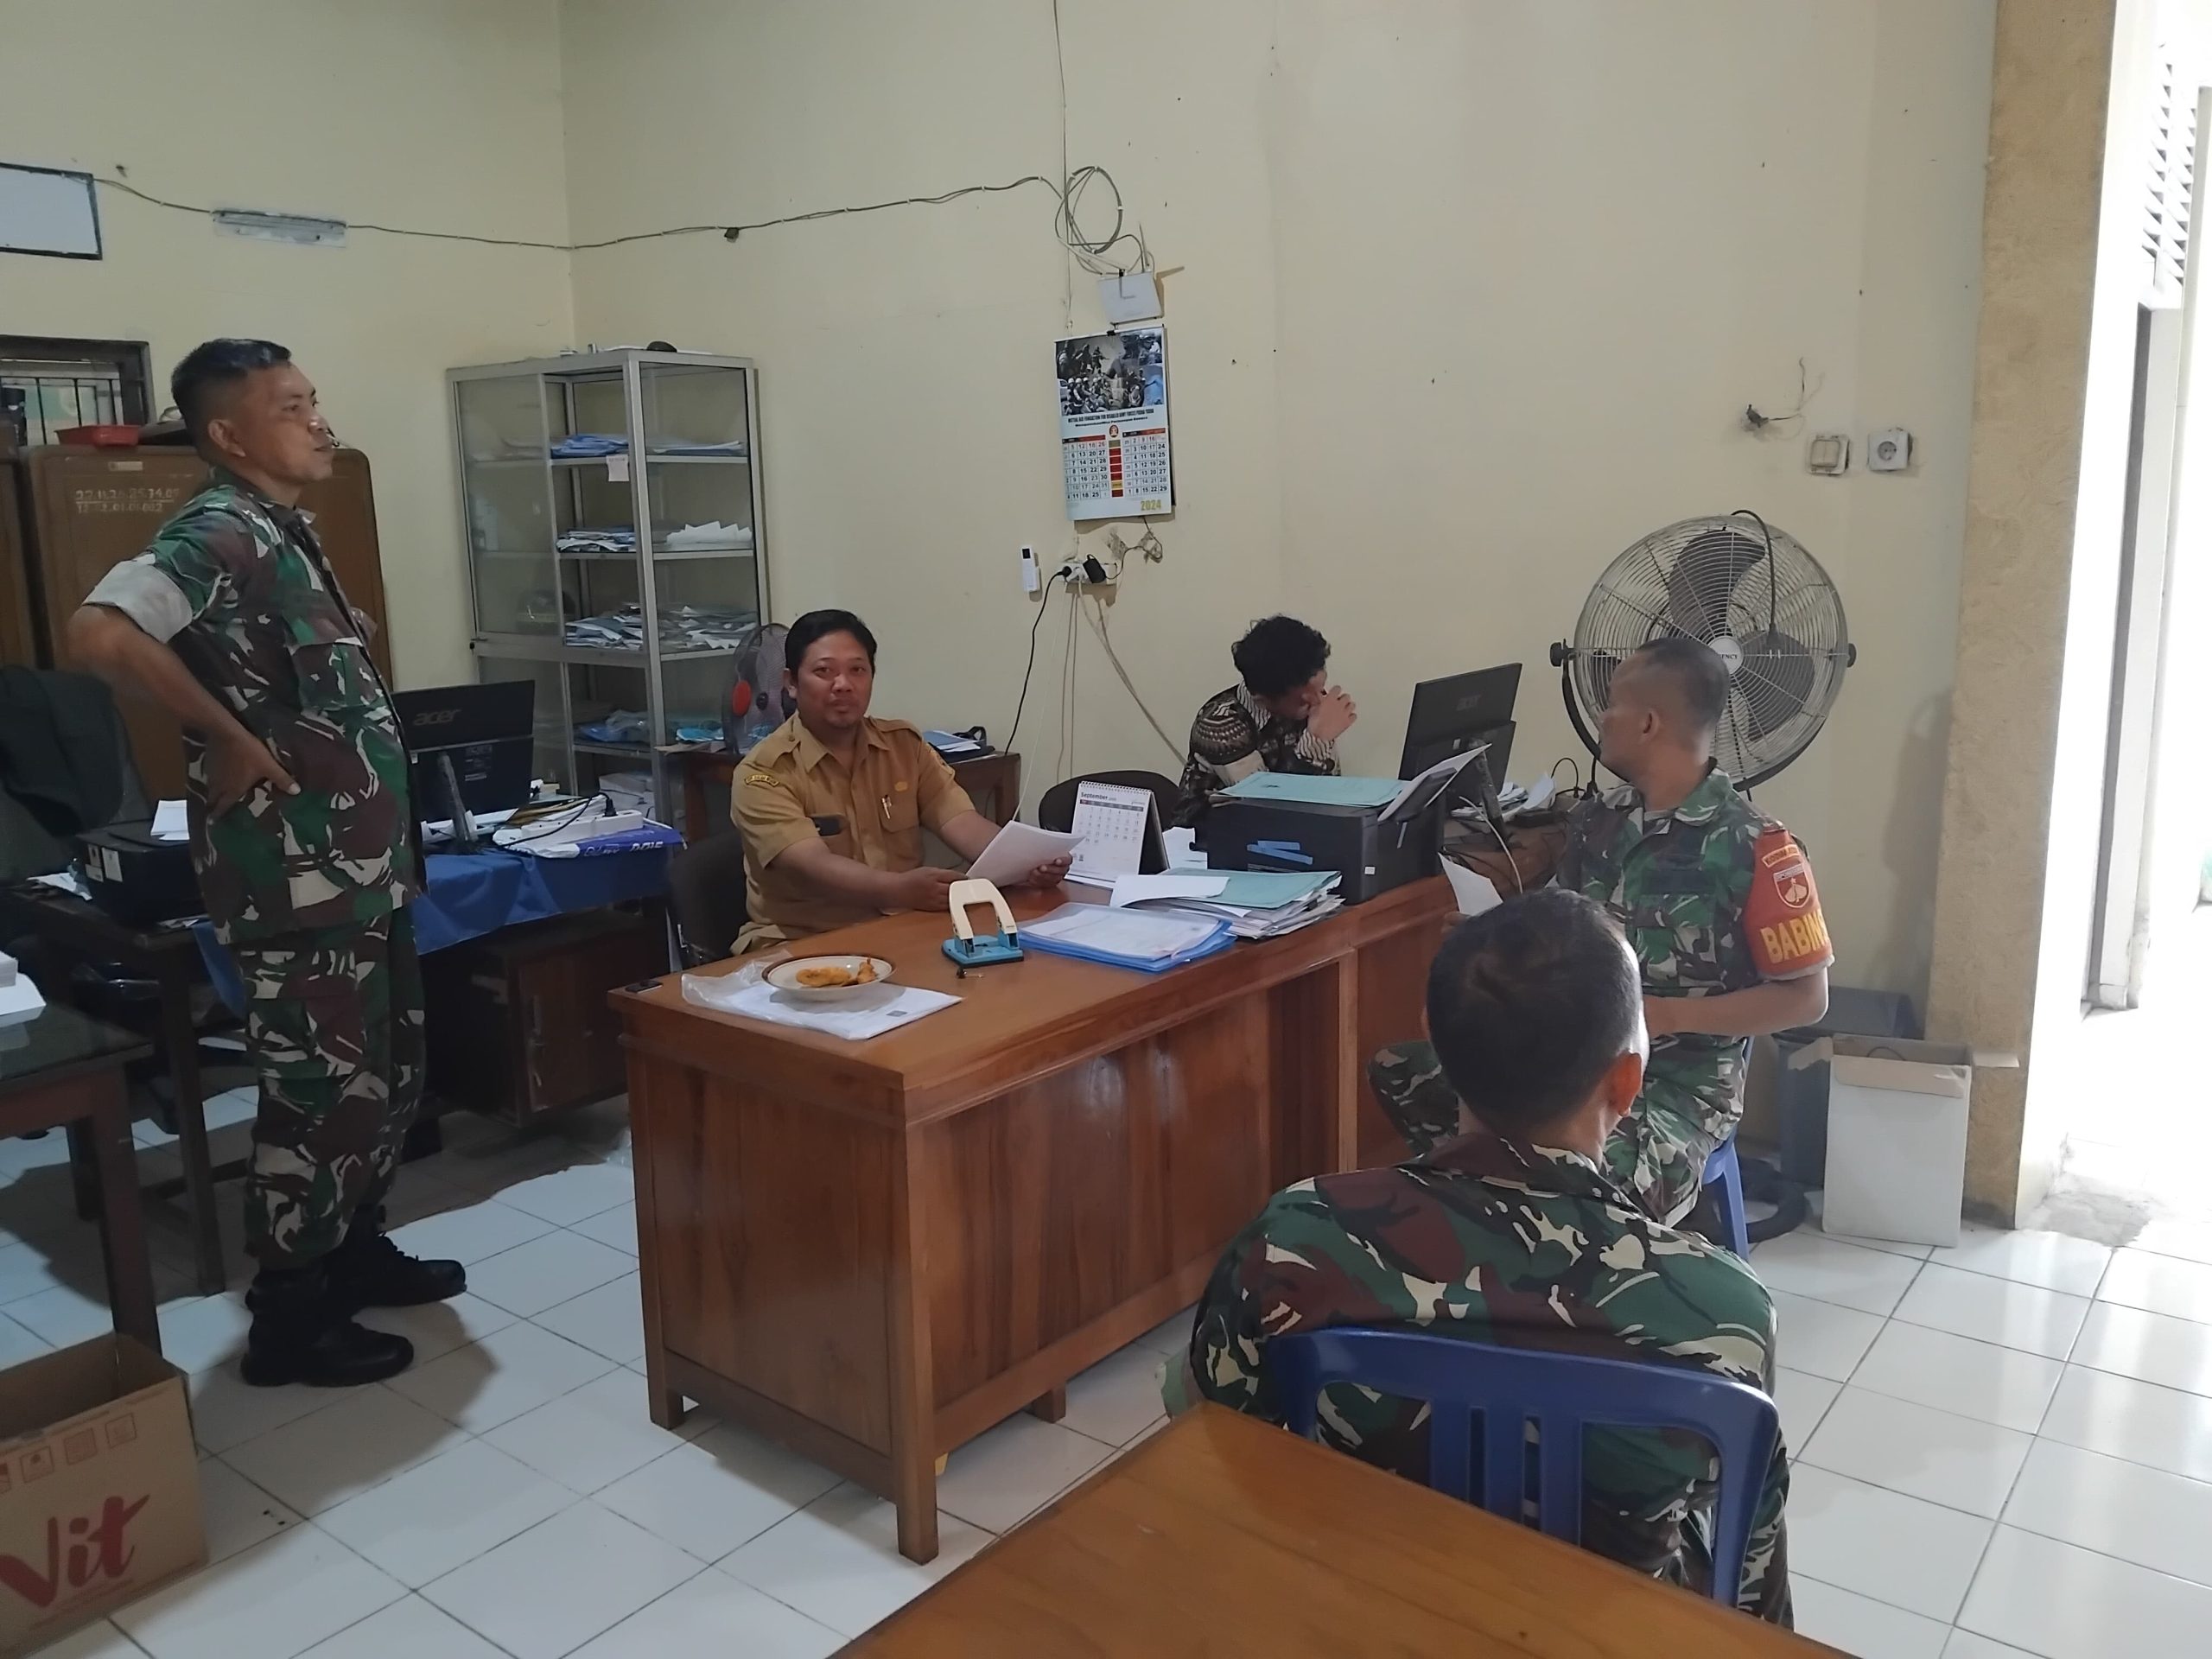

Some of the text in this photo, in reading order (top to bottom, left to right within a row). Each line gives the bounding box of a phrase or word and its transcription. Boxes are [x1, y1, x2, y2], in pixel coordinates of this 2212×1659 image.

[1141, 499, 1161, 511] 2024
[414, 708, 462, 726] acer
[0, 1494, 150, 1608] Vit
